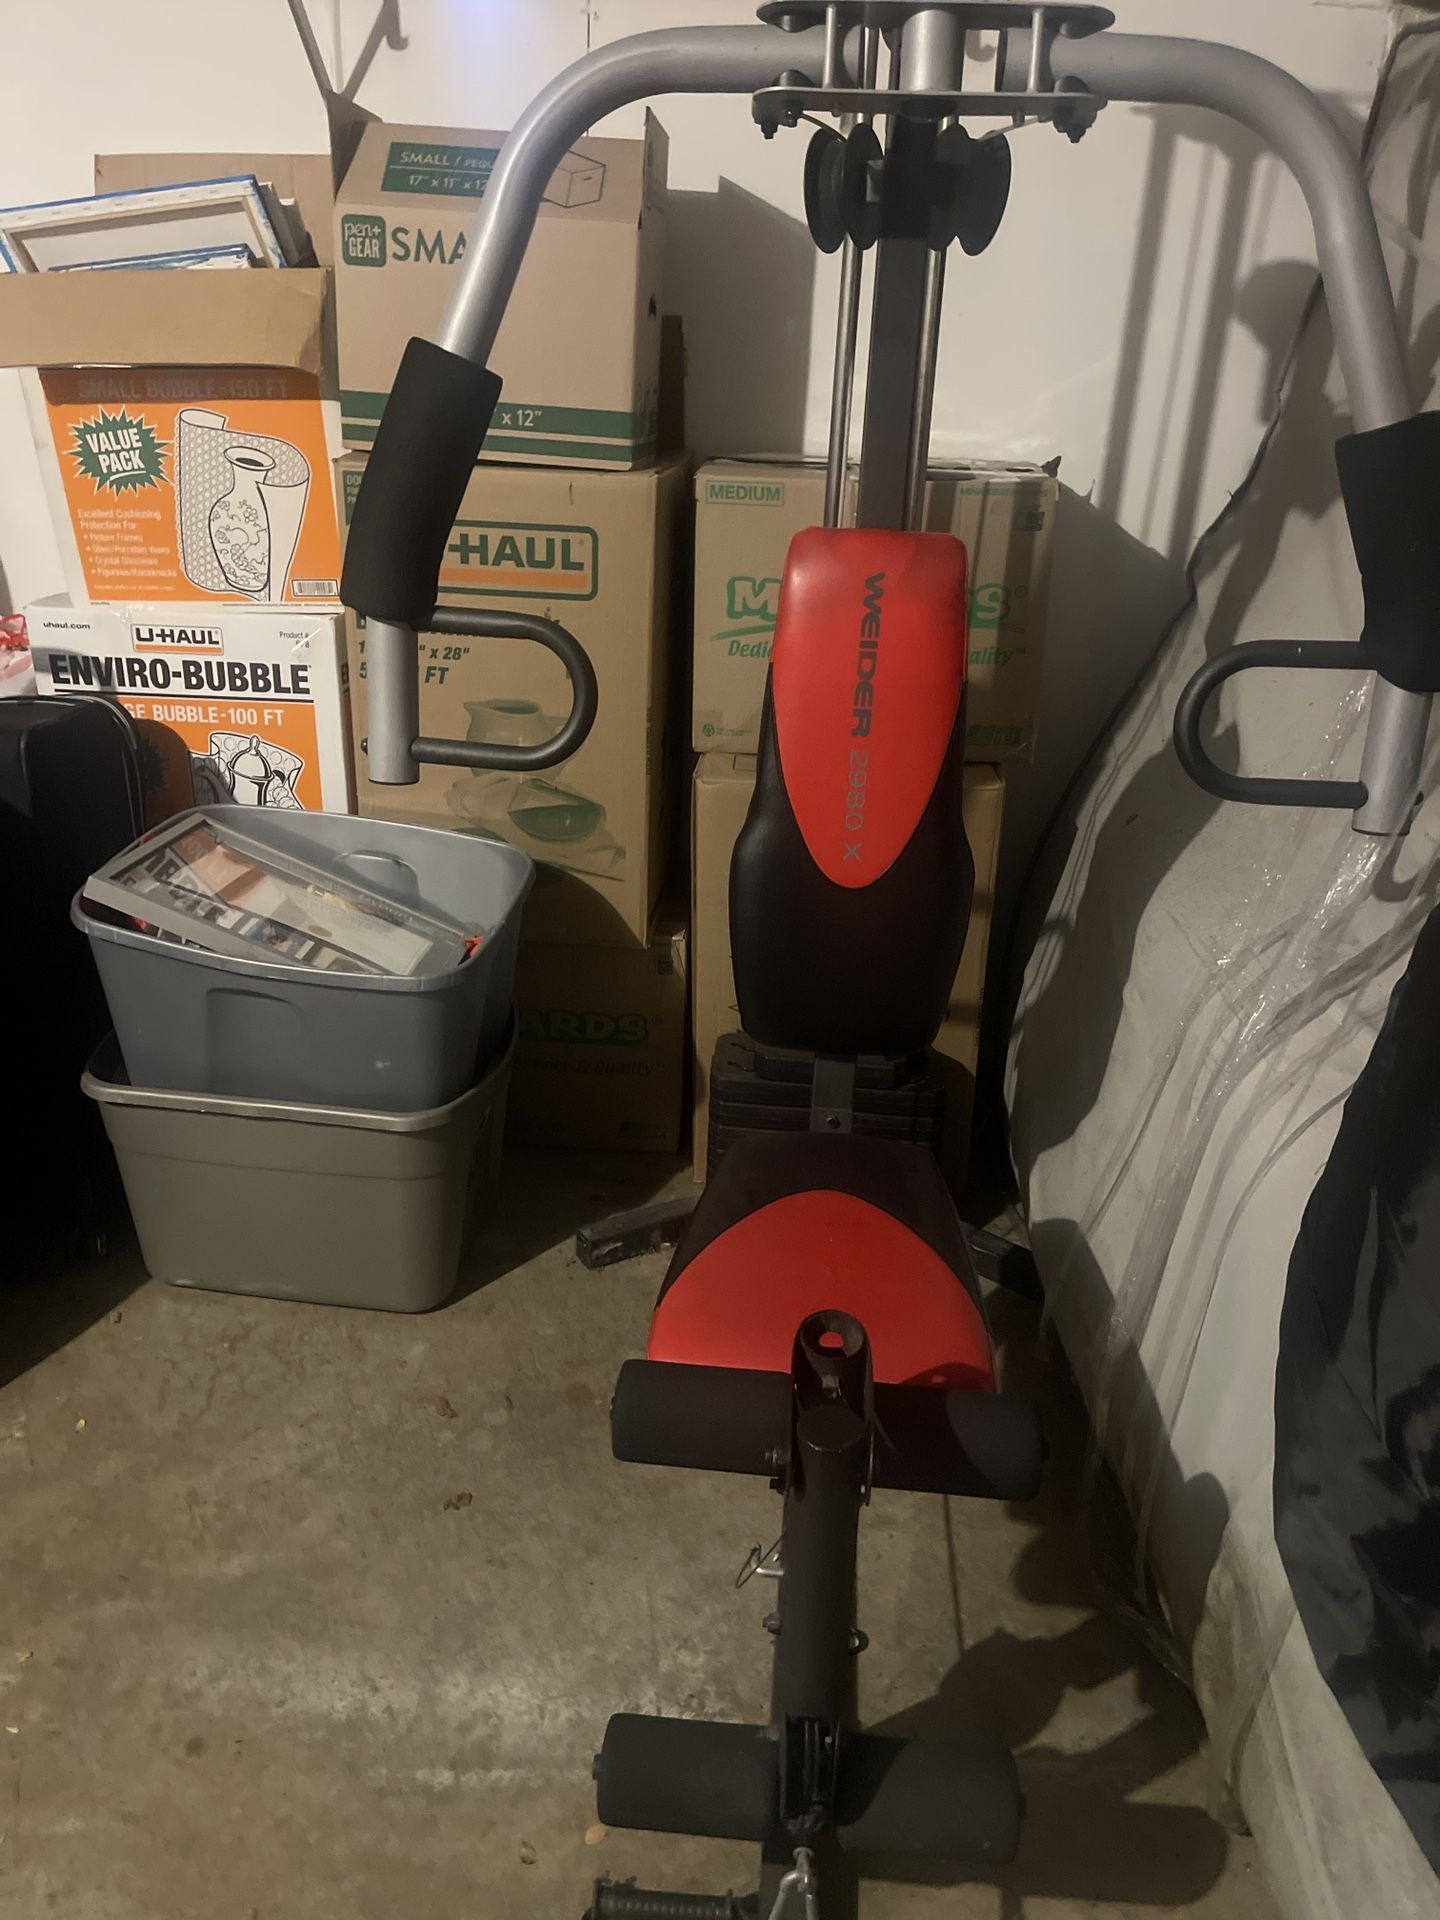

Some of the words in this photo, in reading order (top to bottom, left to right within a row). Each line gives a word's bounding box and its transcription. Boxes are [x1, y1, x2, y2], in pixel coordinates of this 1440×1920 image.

[400, 151, 450, 166] SMALL
[464, 158, 494, 170] PEQU
[431, 179, 439, 188] x
[464, 181, 472, 190] x
[475, 178, 490, 191] 12
[348, 237, 381, 259] GEAR
[391, 227, 467, 265] SMA
[79, 378, 141, 400] SMALL
[146, 378, 259, 399] BUBBLE-150
[265, 378, 288, 399] FT
[502, 412, 511, 426] x
[516, 409, 542, 427] 12"
[85, 428, 143, 454] VALUE
[97, 450, 145, 473] PACK
[709, 484, 781, 502] MEDIUM
[78, 508, 114, 519] Excellent
[116, 509, 161, 521] Cushioning
[80, 519, 121, 530] Protection
[448, 533, 585, 571] -HAUL
[43, 620, 91, 630] uhaul.com
[279, 630, 303, 640] Product
[135, 627, 221, 645] U-HAUL
[429, 647, 440, 660] x
[442, 645, 470, 662] 28"
[728, 639, 771, 659] Dedi
[969, 645, 1013, 668] ality
[851, 571, 886, 737] WEIDER
[49, 653, 311, 695] ENVIRO-BUBBLE
[424, 665, 449, 685] FT
[153, 703, 258, 726] BUBBLE-100
[263, 708, 284, 727] FT
[844, 748, 869, 831] 2980
[842, 841, 863, 862] X
[517, 1009, 649, 1047] ARDS
